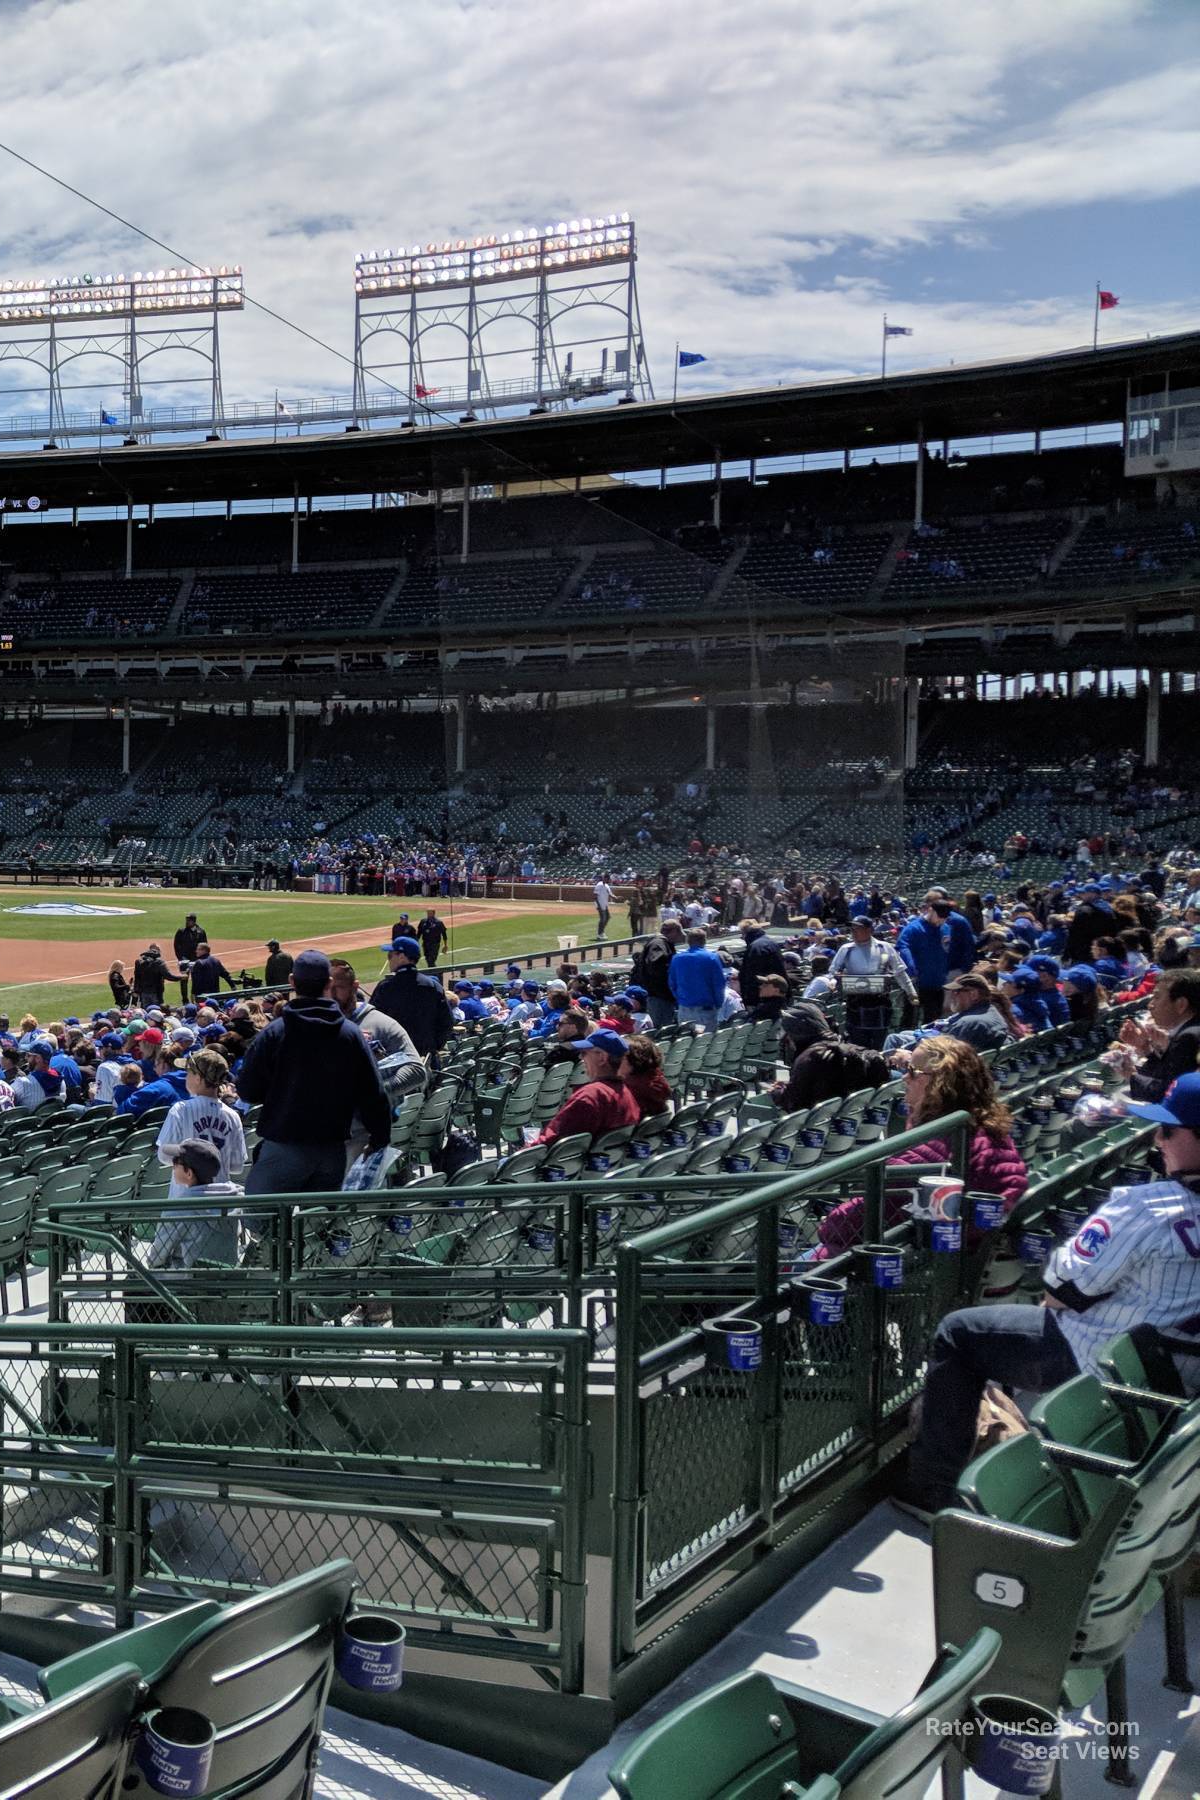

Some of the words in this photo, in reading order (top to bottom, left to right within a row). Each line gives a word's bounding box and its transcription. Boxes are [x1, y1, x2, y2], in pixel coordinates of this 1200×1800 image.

[193, 1115, 232, 1136] BRYANT
[992, 1580, 1007, 1600] 5
[351, 1646, 379, 1661] Hefty
[361, 1661, 389, 1674] Hefty
[150, 1755, 178, 1775] Hefty
[158, 1774, 188, 1791] Hefty
